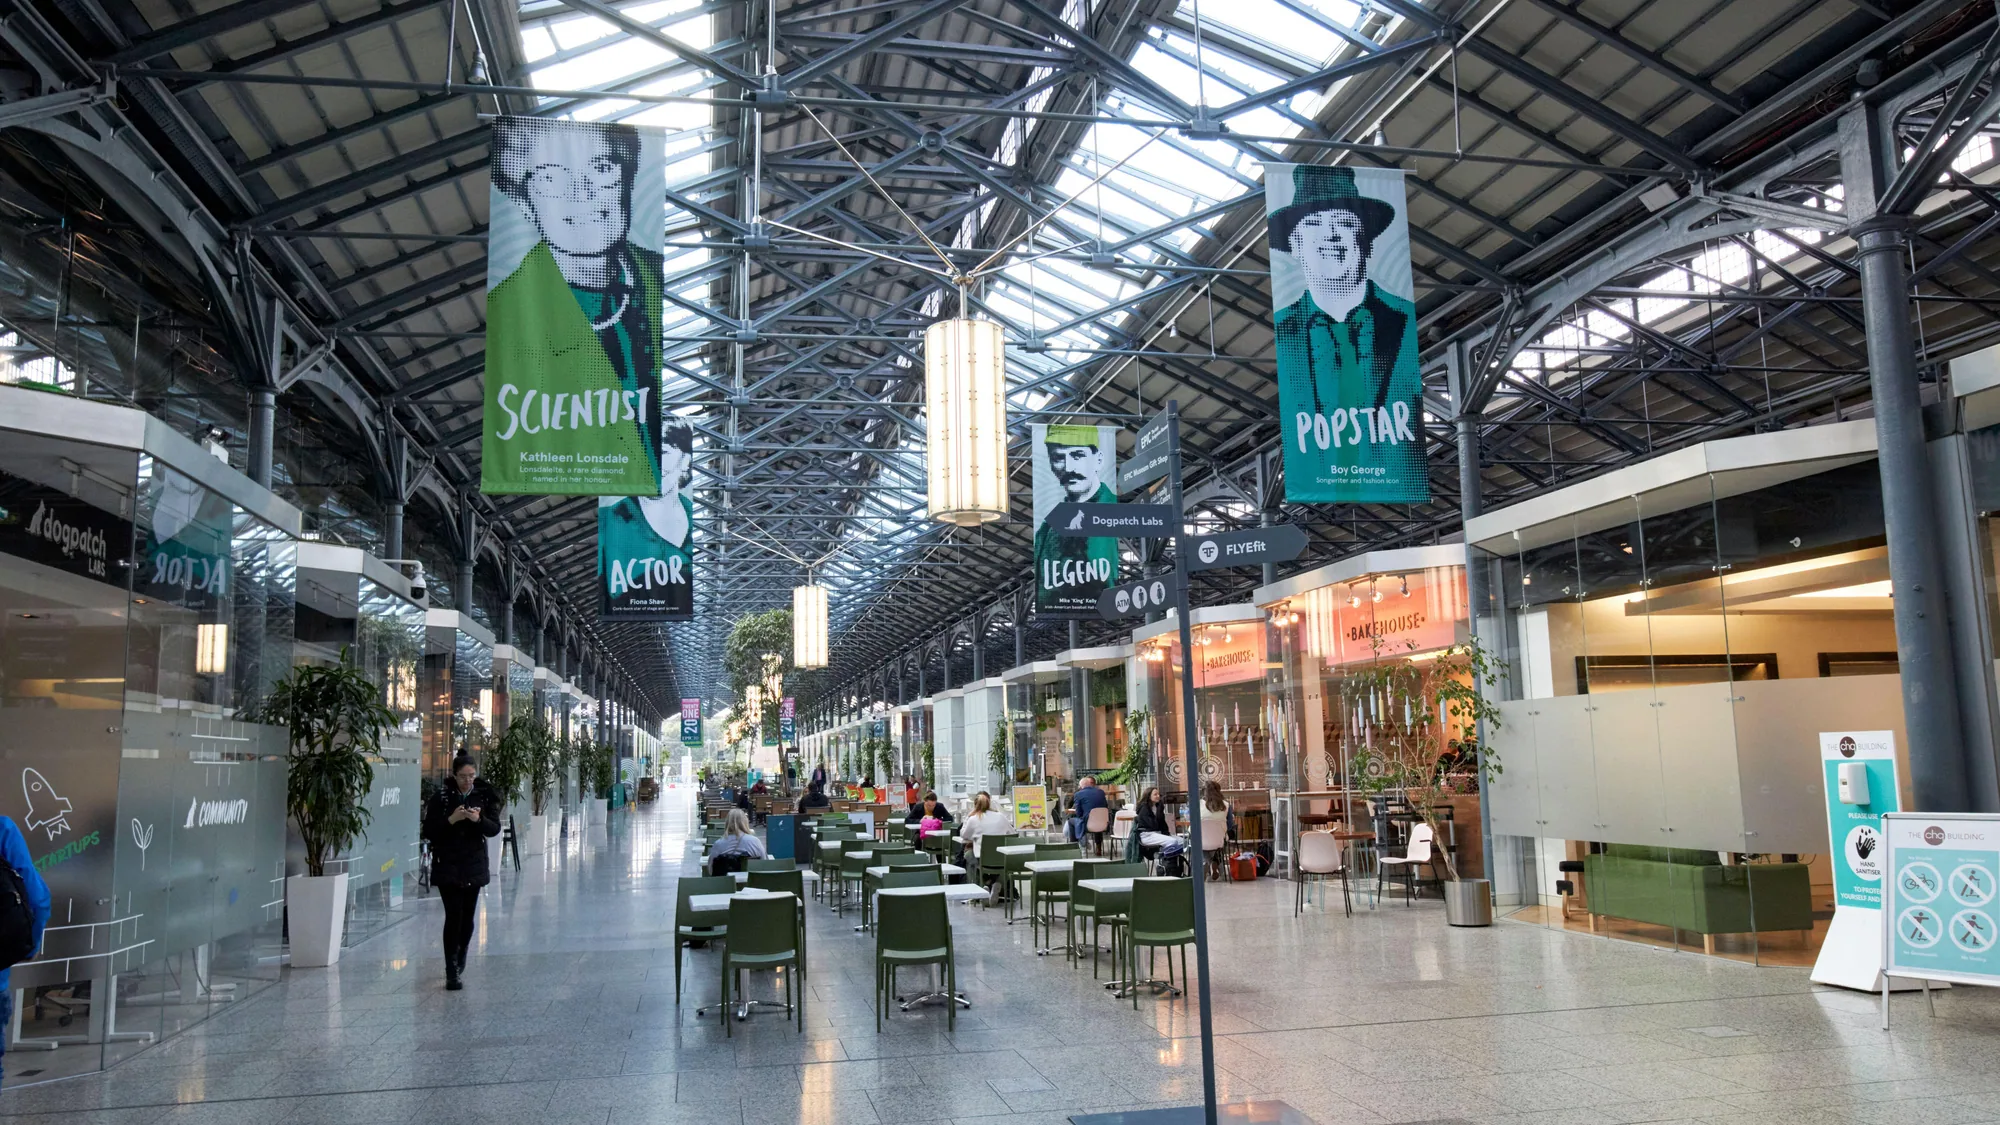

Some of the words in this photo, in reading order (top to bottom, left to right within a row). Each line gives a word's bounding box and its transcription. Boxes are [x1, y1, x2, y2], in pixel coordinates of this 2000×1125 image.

[495, 383, 650, 441] SCIENTIST
[1296, 401, 1416, 454] POPSTAR
[520, 452, 574, 463] Kathleen
[576, 453, 629, 464] Lonsdale
[1123, 471, 1133, 482] EPIC
[1157, 455, 1169, 466] Shop
[1330, 464, 1349, 476] Boy
[1350, 465, 1386, 476] George
[1316, 476, 1349, 485] Songwriter
[1092, 515, 1140, 528] Dogpatch
[1141, 516, 1164, 527] Labs
[43, 508, 107, 560] dogpatch
[1226, 541, 1267, 556] FLYEfit
[88, 558, 106, 577] LABS
[611, 554, 686, 594] ACTOR
[1043, 557, 1111, 590] LEGEND
[1116, 598, 1130, 608] ATM
[1351, 612, 1421, 641] BAKEHOUSE
[1210, 649, 1251, 670] BAKEHOUSE
[682, 709, 699, 719] ONE
[684, 719, 698, 734] 20
[1827, 743, 1838, 751] THE
[1858, 742, 1888, 751] BUILDING
[199, 799, 249, 828] COMMUNITY
[1848, 812, 1867, 820] PLEASE
[1908, 831, 1921, 839] THE
[1947, 832, 1985, 841] BUILDING
[33, 830, 101, 873] STARTUPS
[1855, 868, 1881, 876] SANITISER
[1853, 885, 1862, 893] TO
[1840, 892, 1867, 901] YOURSELF
[1867, 895, 1881, 903] AND
